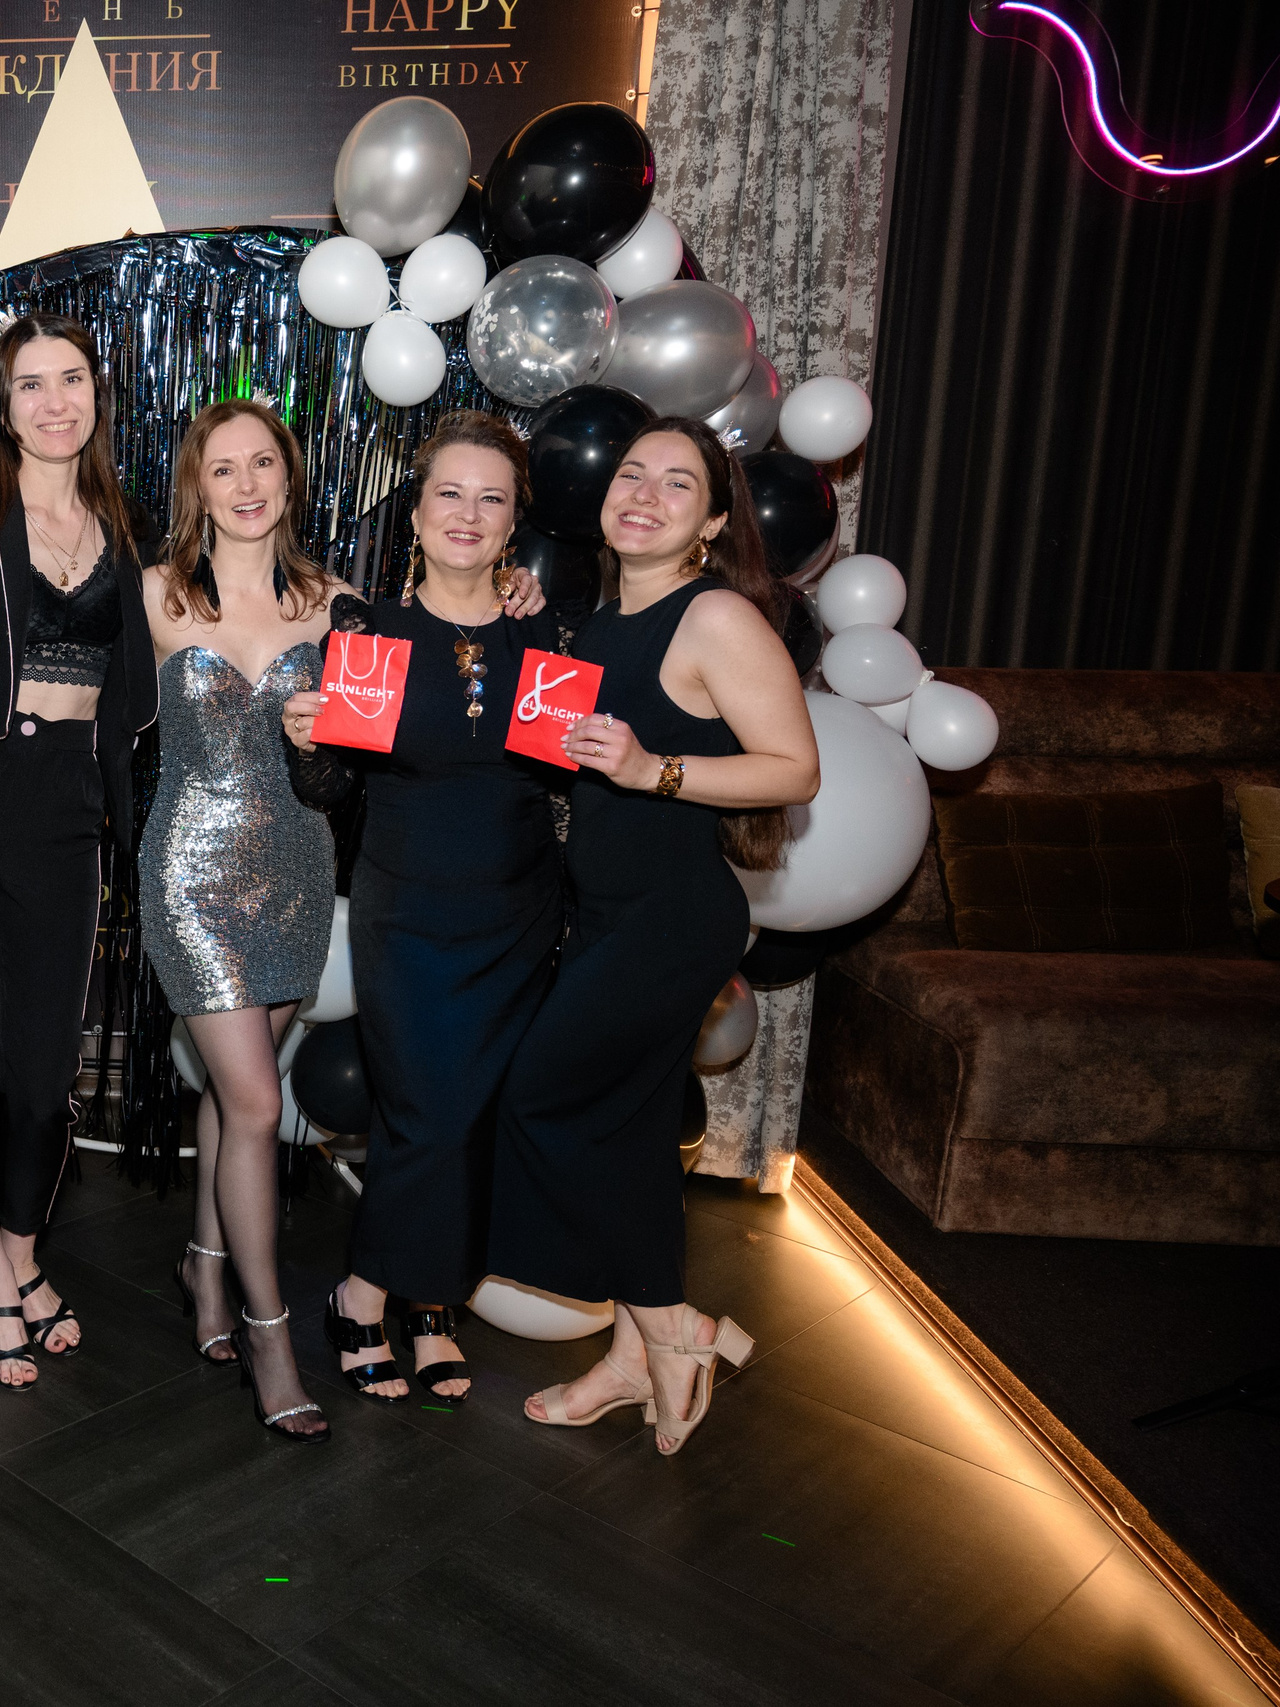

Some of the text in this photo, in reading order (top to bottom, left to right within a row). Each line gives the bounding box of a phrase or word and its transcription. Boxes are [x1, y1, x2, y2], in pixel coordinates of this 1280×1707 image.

[341, 0, 522, 34] HAPPY
[337, 61, 529, 88] BIRTHDAY
[326, 682, 395, 700] SUNLIGHT
